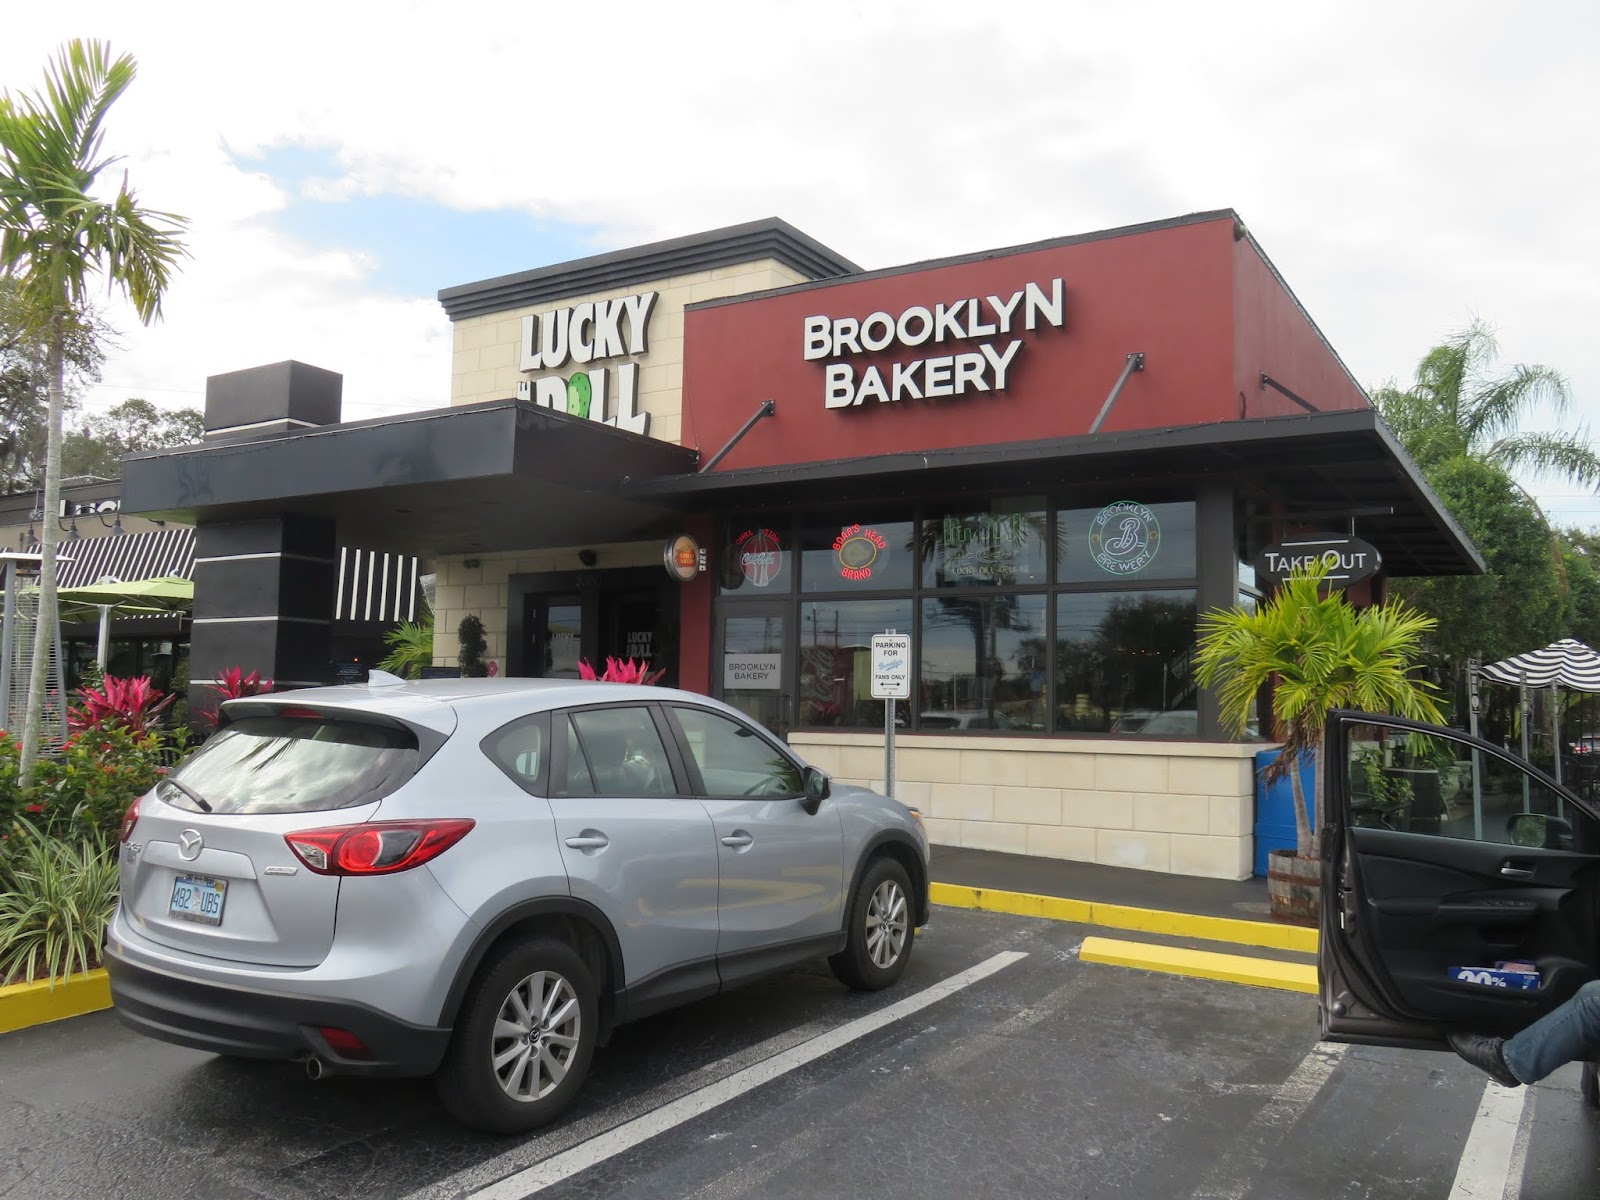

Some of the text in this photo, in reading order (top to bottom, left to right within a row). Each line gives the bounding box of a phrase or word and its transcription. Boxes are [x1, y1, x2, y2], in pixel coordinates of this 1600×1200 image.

[520, 291, 659, 372] LUCKY
[803, 278, 1065, 361] BROOKLYN
[825, 340, 1024, 409] BAKERY
[1096, 502, 1154, 526] BROOKLYN
[832, 523, 887, 550] BOAR'S HEAD
[1096, 550, 1150, 571] BREWERY
[841, 567, 872, 580] BRAND
[627, 631, 653, 643] LUCKY
[728, 663, 776, 671] BROOKLYN
[734, 672, 769, 680] BAKERY
[173, 887, 220, 914] 482 UBS
